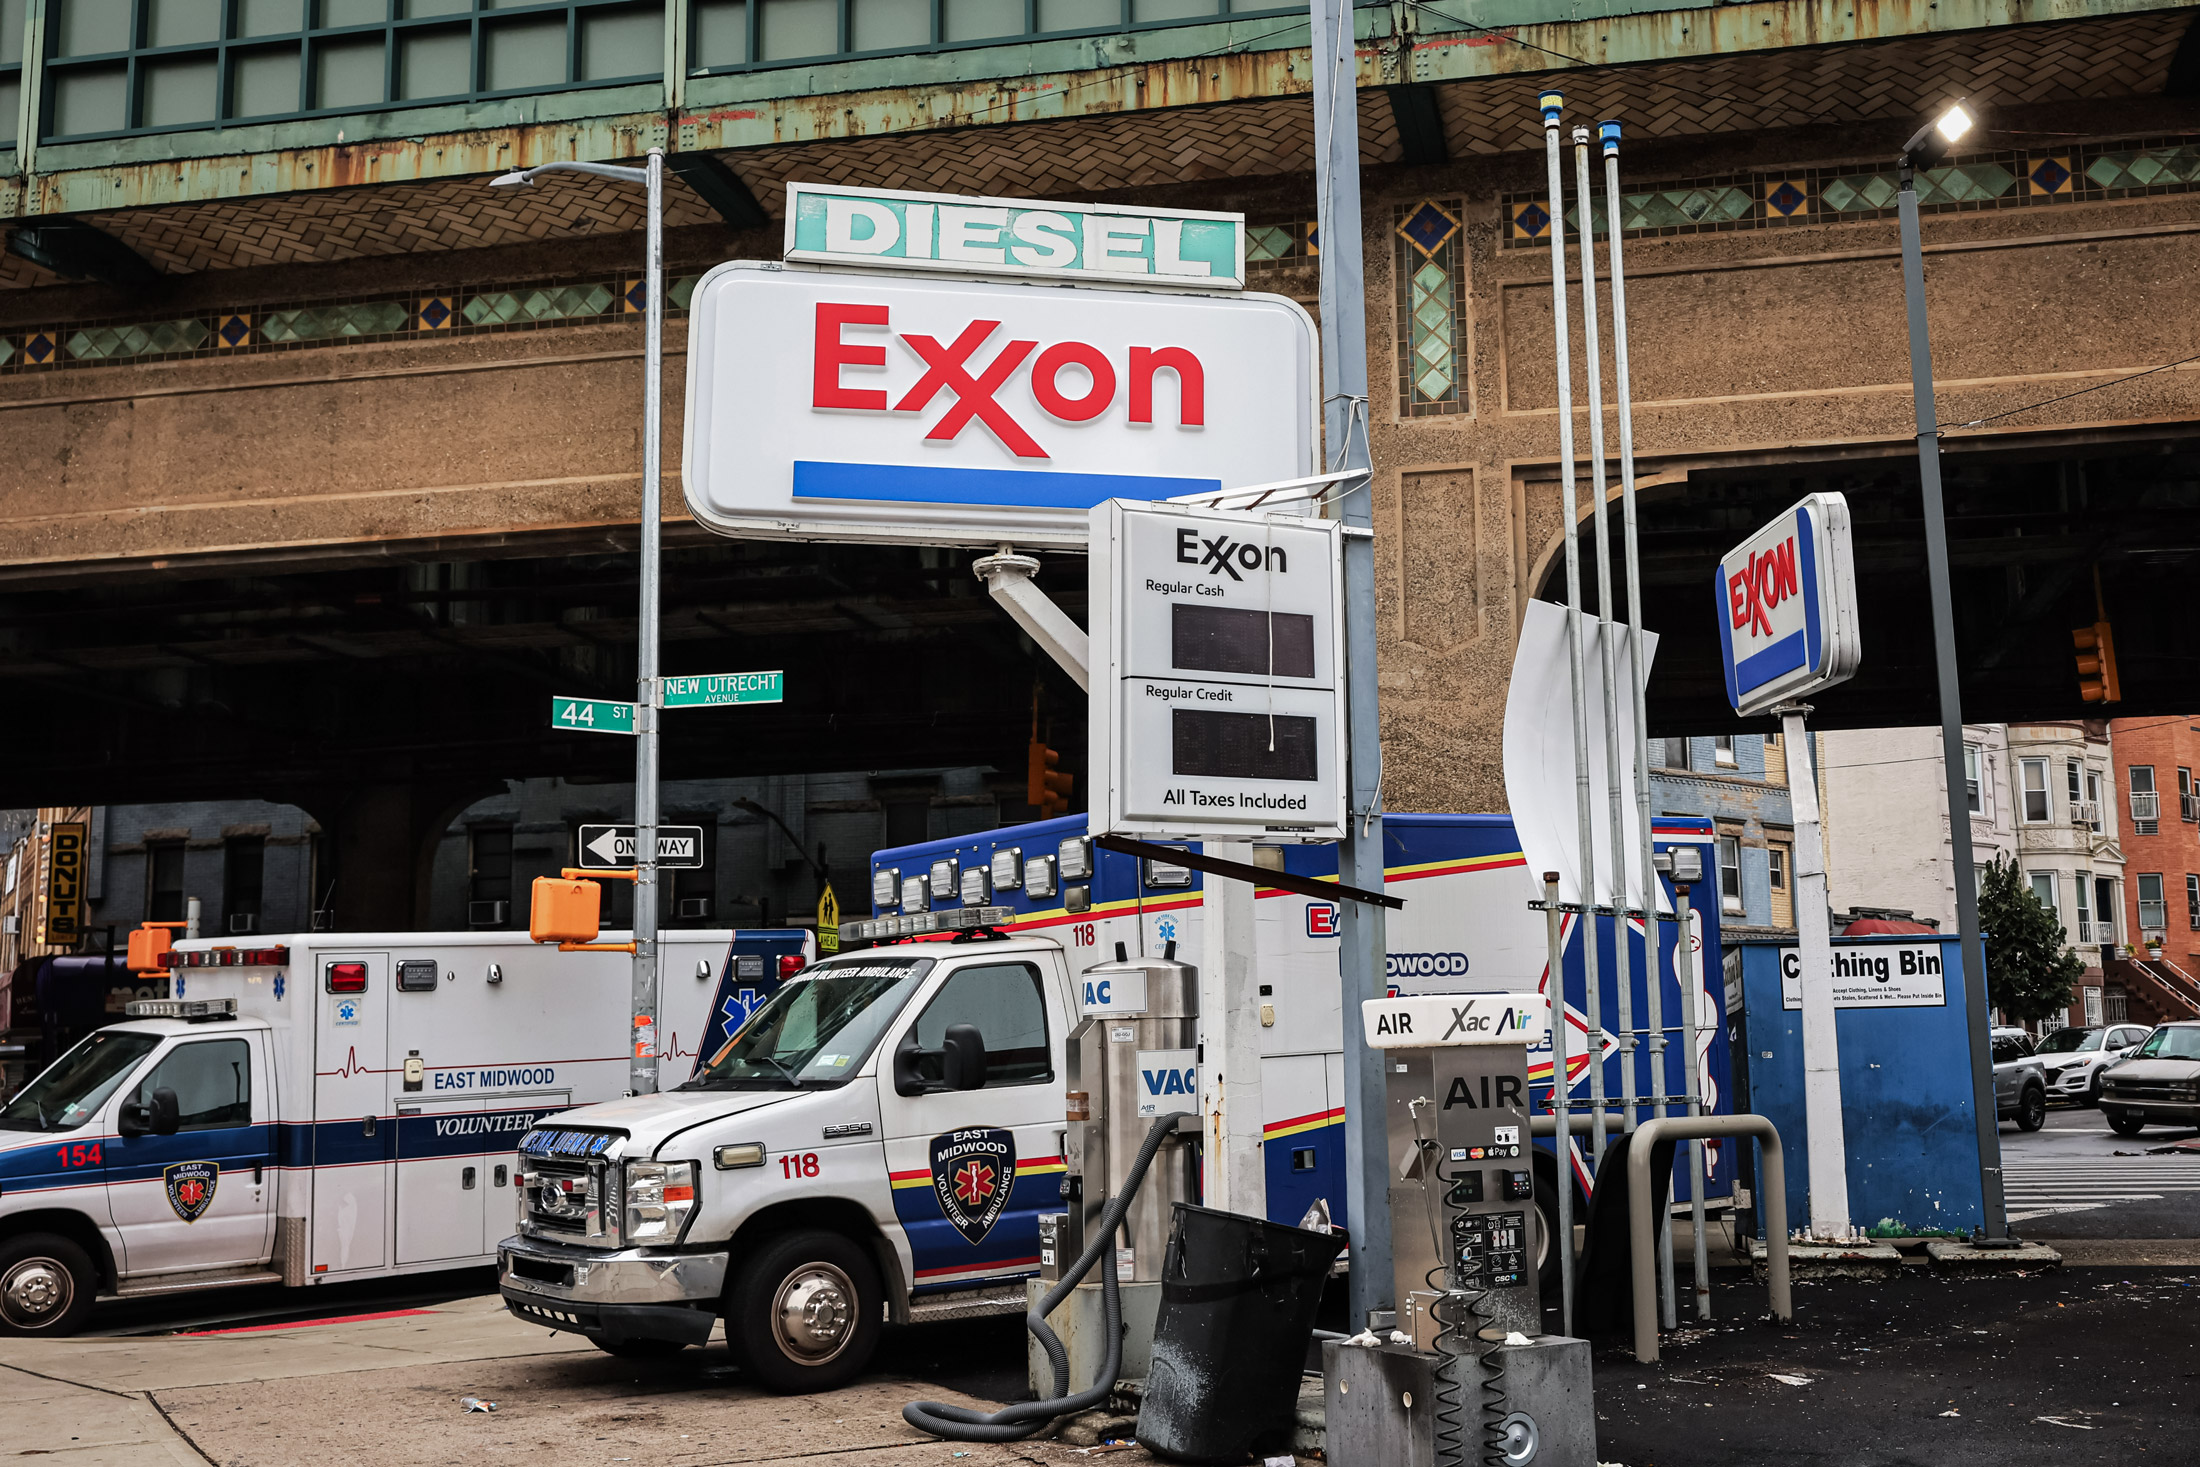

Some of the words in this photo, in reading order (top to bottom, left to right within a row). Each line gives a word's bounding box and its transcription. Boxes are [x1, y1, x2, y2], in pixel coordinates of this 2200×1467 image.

[825, 198, 1212, 277] DIESEL
[812, 302, 1205, 459] Exxon
[1176, 527, 1288, 582] Exxon
[1146, 579, 1193, 595] Regular
[1196, 583, 1225, 597] Cash
[1729, 535, 1798, 638] EXXON
[666, 678, 700, 696] NEW
[707, 674, 778, 693] UTRECHT
[1146, 685, 1193, 701] Regular
[1196, 690, 1233, 702] Credit
[704, 693, 739, 703] AVENUE
[561, 702, 594, 727] 44
[612, 706, 628, 719] ST
[1163, 789, 1186, 806] All
[1190, 791, 1235, 808] Taxes
[1240, 792, 1307, 810] Included
[614, 839, 636, 854] ON
[658, 840, 689, 854] WAY
[53, 835, 79, 933] DONUTS
[1073, 924, 1095, 946] 118
[857, 967, 917, 979] AMBULANCE
[1386, 956, 1467, 974] DWOOD
[1783, 952, 1890, 983] Ching
[1899, 950, 1941, 976] Bin
[1082, 980, 1111, 1005] AC
[1377, 1013, 1413, 1035] AIR
[1442, 1000, 1490, 1040] Xac
[1495, 1008, 1532, 1036] Air
[435, 1072, 475, 1089] EAST
[480, 1069, 554, 1087] MIDWOOD
[1142, 1068, 1195, 1096] VAC
[1443, 1076, 1524, 1110] AIR
[435, 1113, 534, 1136] VOLUNTEER
[953, 1129, 990, 1143] EAST
[57, 1143, 102, 1168] 154
[937, 1141, 1008, 1162] MIDWOOD
[1494, 1148, 1507, 1157] Pay
[173, 1170, 211, 1181] MIDWOOD
[180, 1164, 203, 1172] EAST
[778, 1152, 820, 1180] 118
[936, 1173, 969, 1230] VOLUNTEER
[982, 1166, 1012, 1229] AMBULANCE
